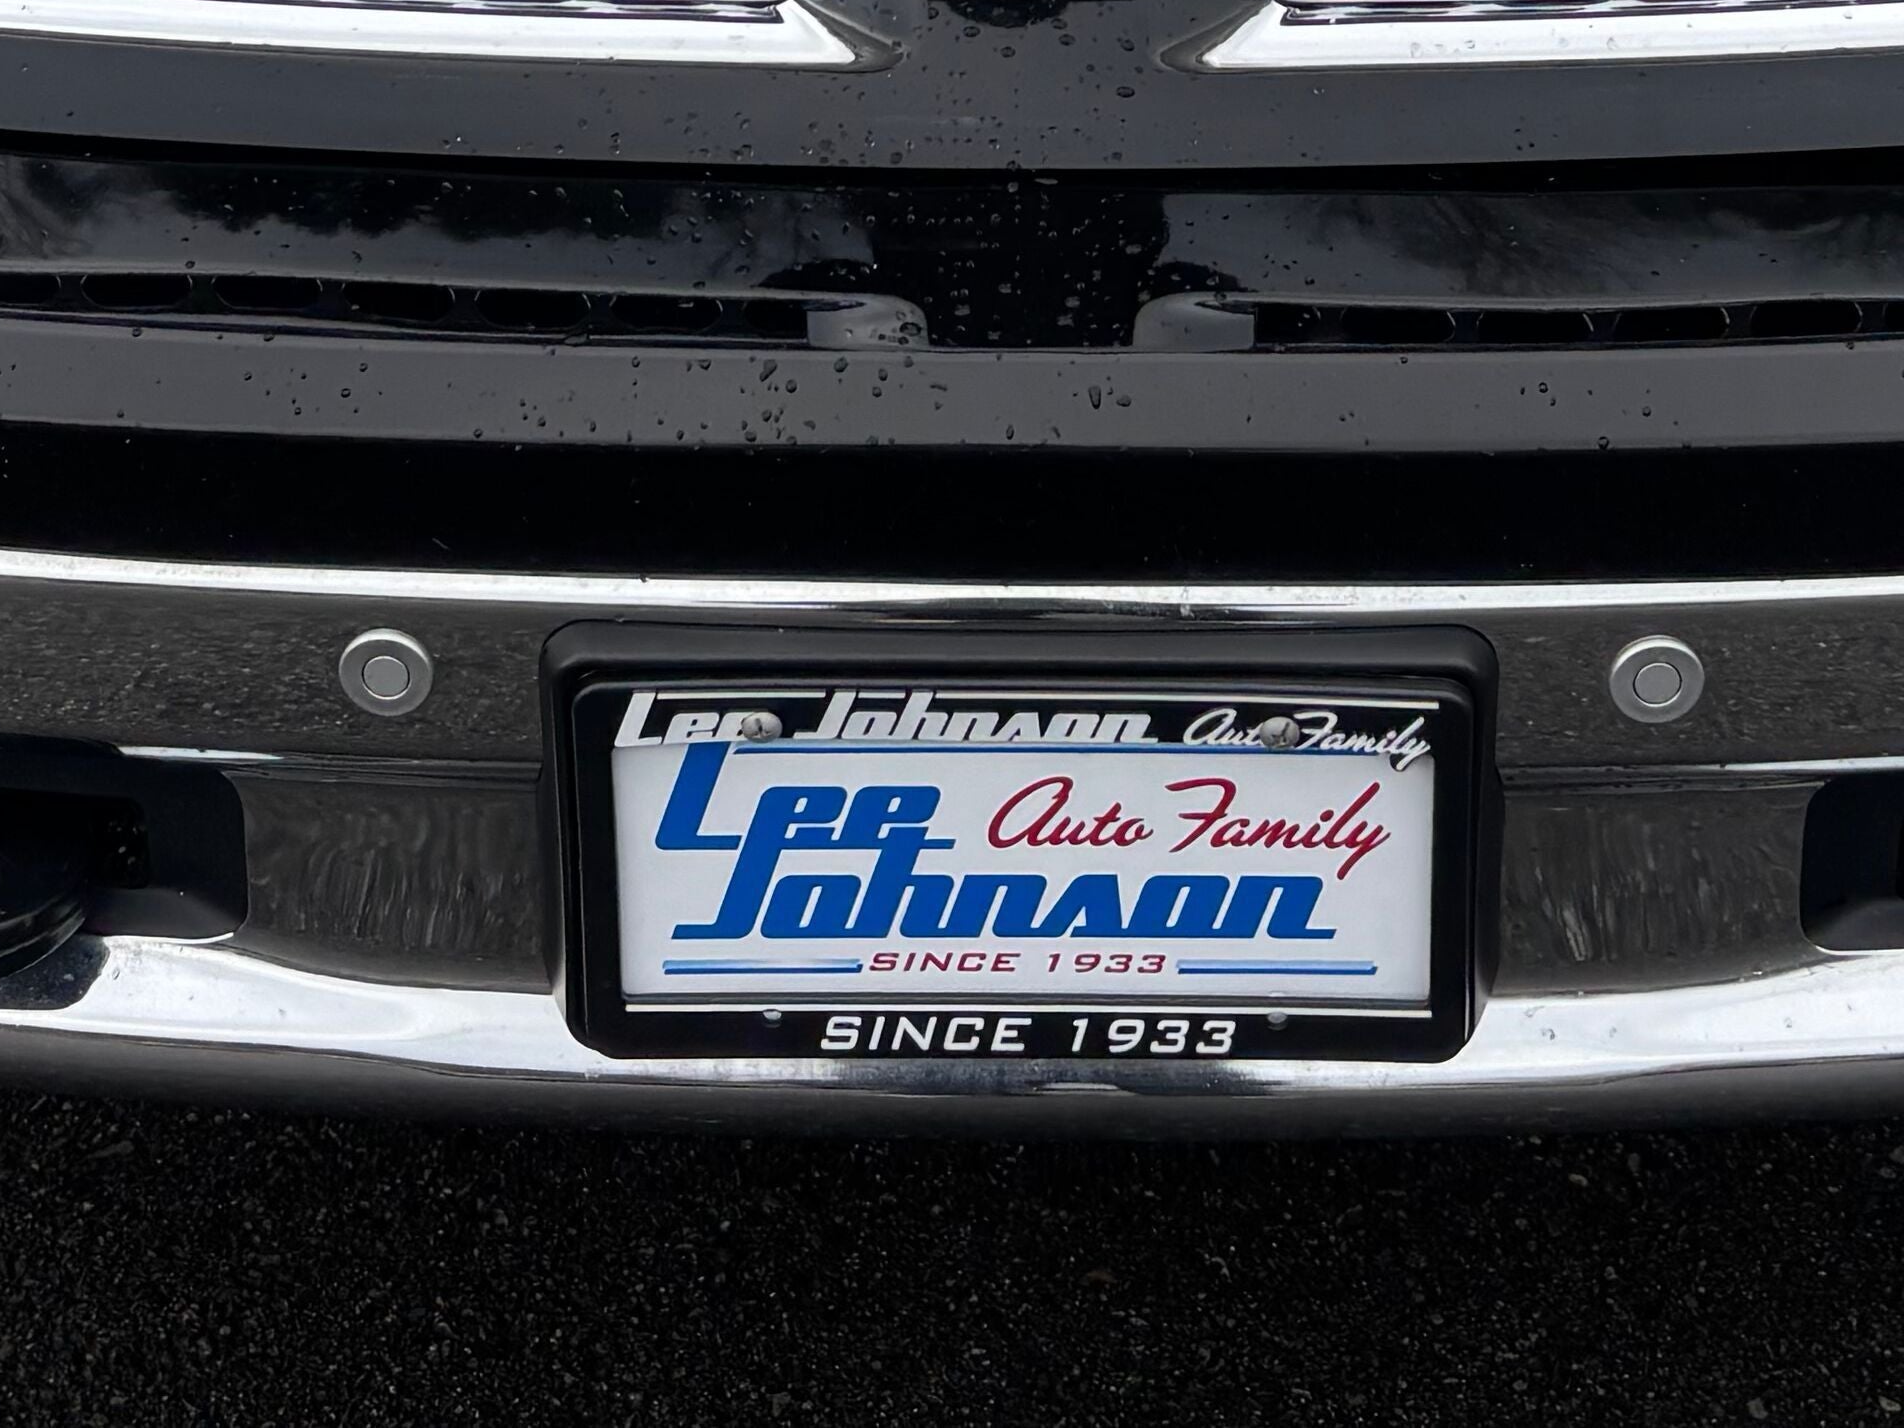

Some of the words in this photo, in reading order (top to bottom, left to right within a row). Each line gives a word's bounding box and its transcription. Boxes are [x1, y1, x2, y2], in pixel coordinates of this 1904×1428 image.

[792, 689, 1160, 743] Johnson
[1182, 707, 1271, 746] Aut
[1293, 711, 1431, 772] Family
[654, 740, 956, 851] Lee
[986, 775, 1154, 850] Auto
[1164, 777, 1391, 881] Family
[670, 834, 1338, 941] Johnson
[868, 952, 1022, 973] SINCE
[1047, 952, 1168, 974] 1933
[819, 1015, 1033, 1051] SINCE
[1071, 1017, 1237, 1056] 1933
